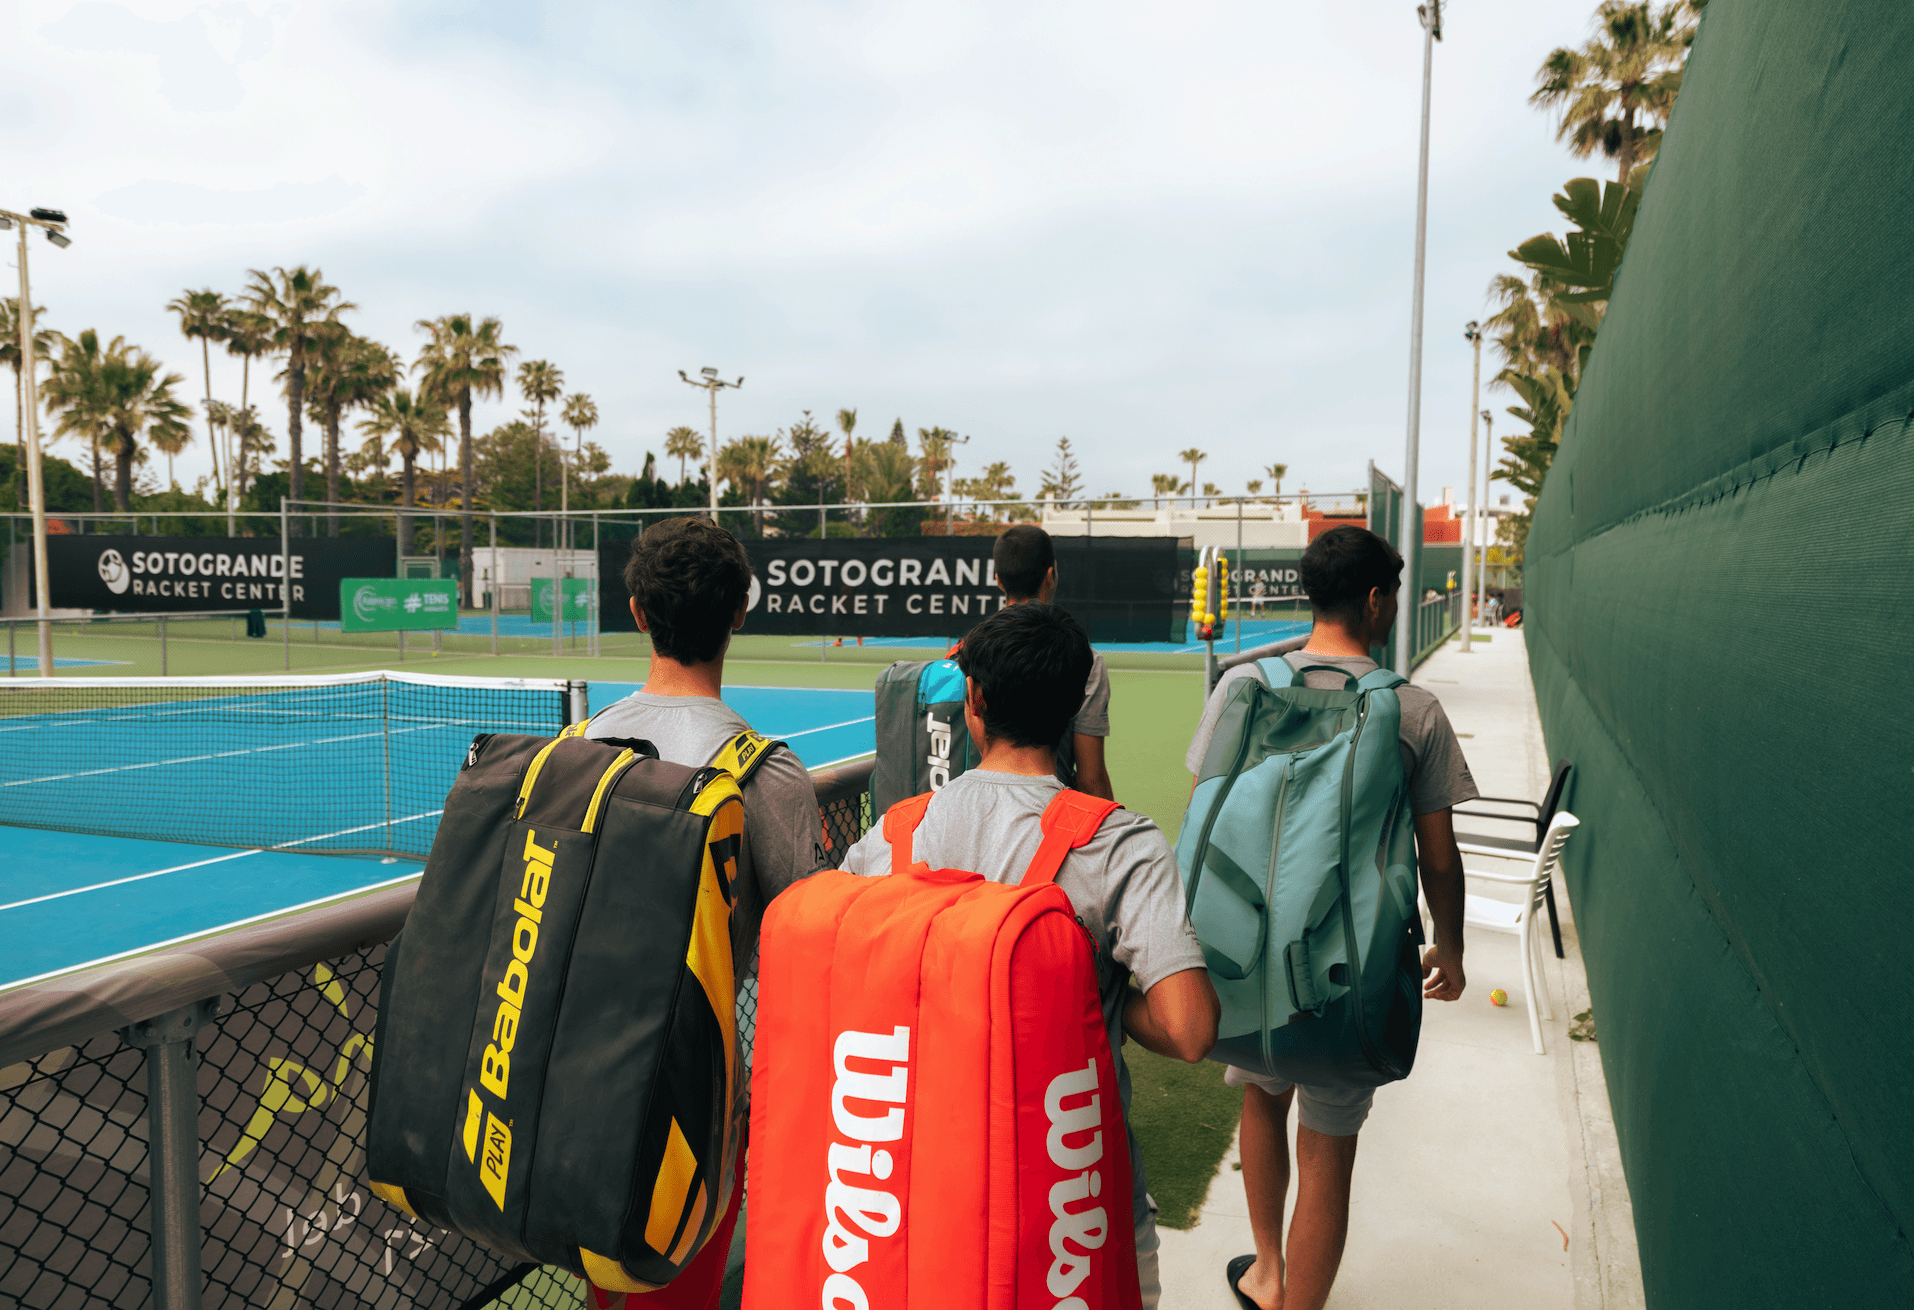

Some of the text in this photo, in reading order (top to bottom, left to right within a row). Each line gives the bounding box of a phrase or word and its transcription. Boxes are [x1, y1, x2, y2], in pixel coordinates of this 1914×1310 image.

[132, 551, 304, 578] SOTOGRANDE
[132, 579, 305, 602] RACKET CENTER
[766, 594, 889, 614] RACKET
[479, 829, 556, 1101] Babolat
[486, 1122, 507, 1181] PLAY
[1044, 1057, 1109, 1310] Wils
